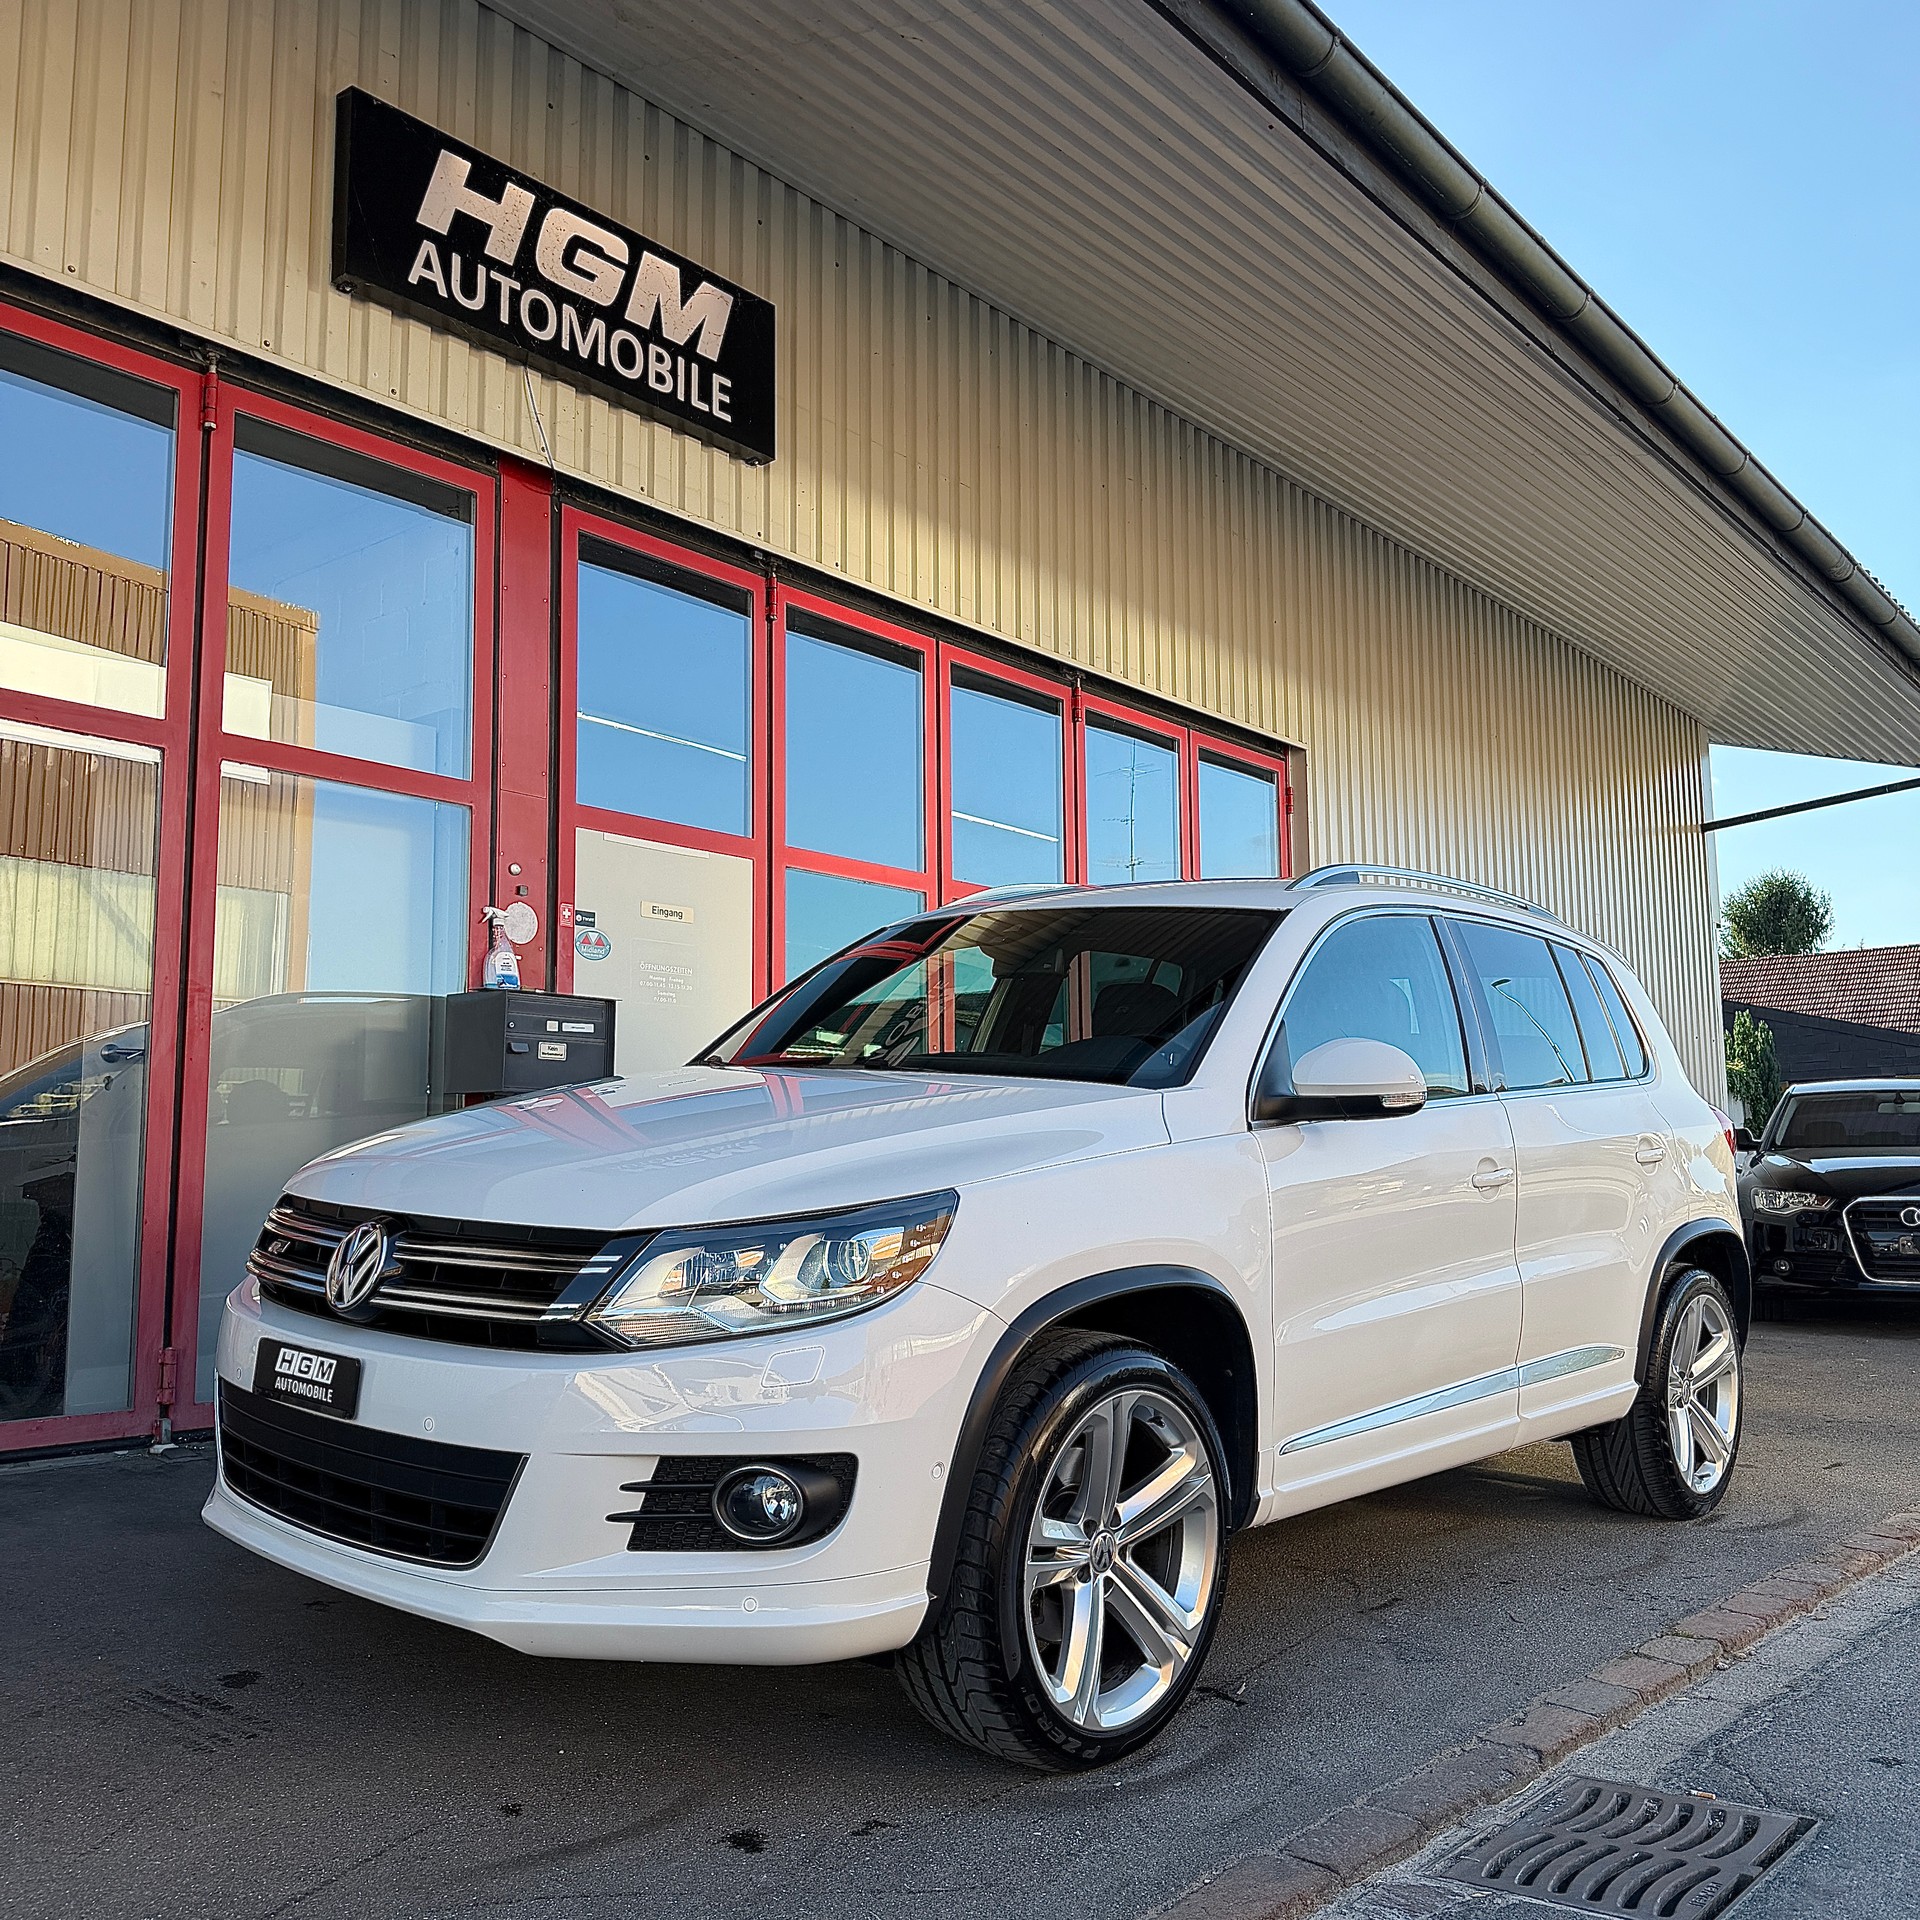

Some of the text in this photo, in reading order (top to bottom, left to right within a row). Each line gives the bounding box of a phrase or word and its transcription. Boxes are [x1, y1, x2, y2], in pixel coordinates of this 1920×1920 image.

[416, 148, 734, 362] HGM
[408, 240, 732, 423] AUTOMOBILE
[651, 905, 684, 920] Eingang
[639, 961, 693, 975] ÖFFNUNGSZEITEN
[275, 1348, 337, 1385] HGM
[275, 1376, 333, 1403] AUTOMOBILE
